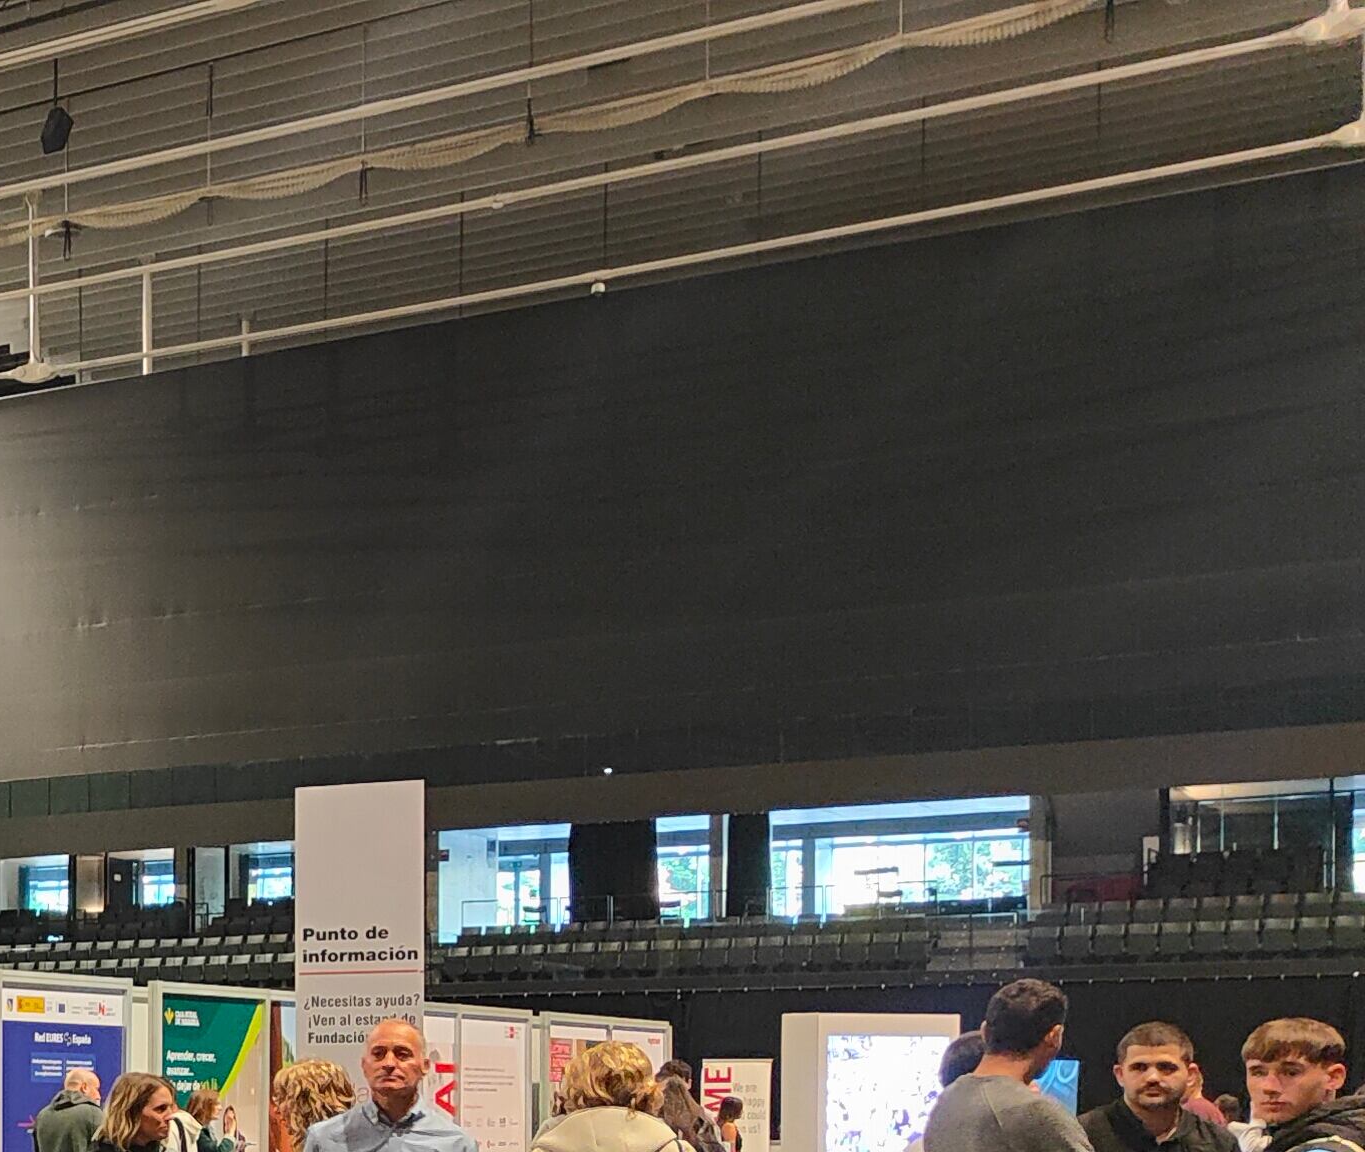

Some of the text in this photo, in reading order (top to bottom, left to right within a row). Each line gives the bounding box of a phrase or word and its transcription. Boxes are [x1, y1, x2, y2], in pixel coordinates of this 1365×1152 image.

[303, 926, 389, 942] Punto de
[303, 946, 419, 963] información
[304, 993, 420, 1010] ¿Necesitas ayuda?
[308, 1014, 336, 1029] ¡Ven
[339, 1014, 351, 1026] al
[308, 1032, 368, 1044] Fundació
